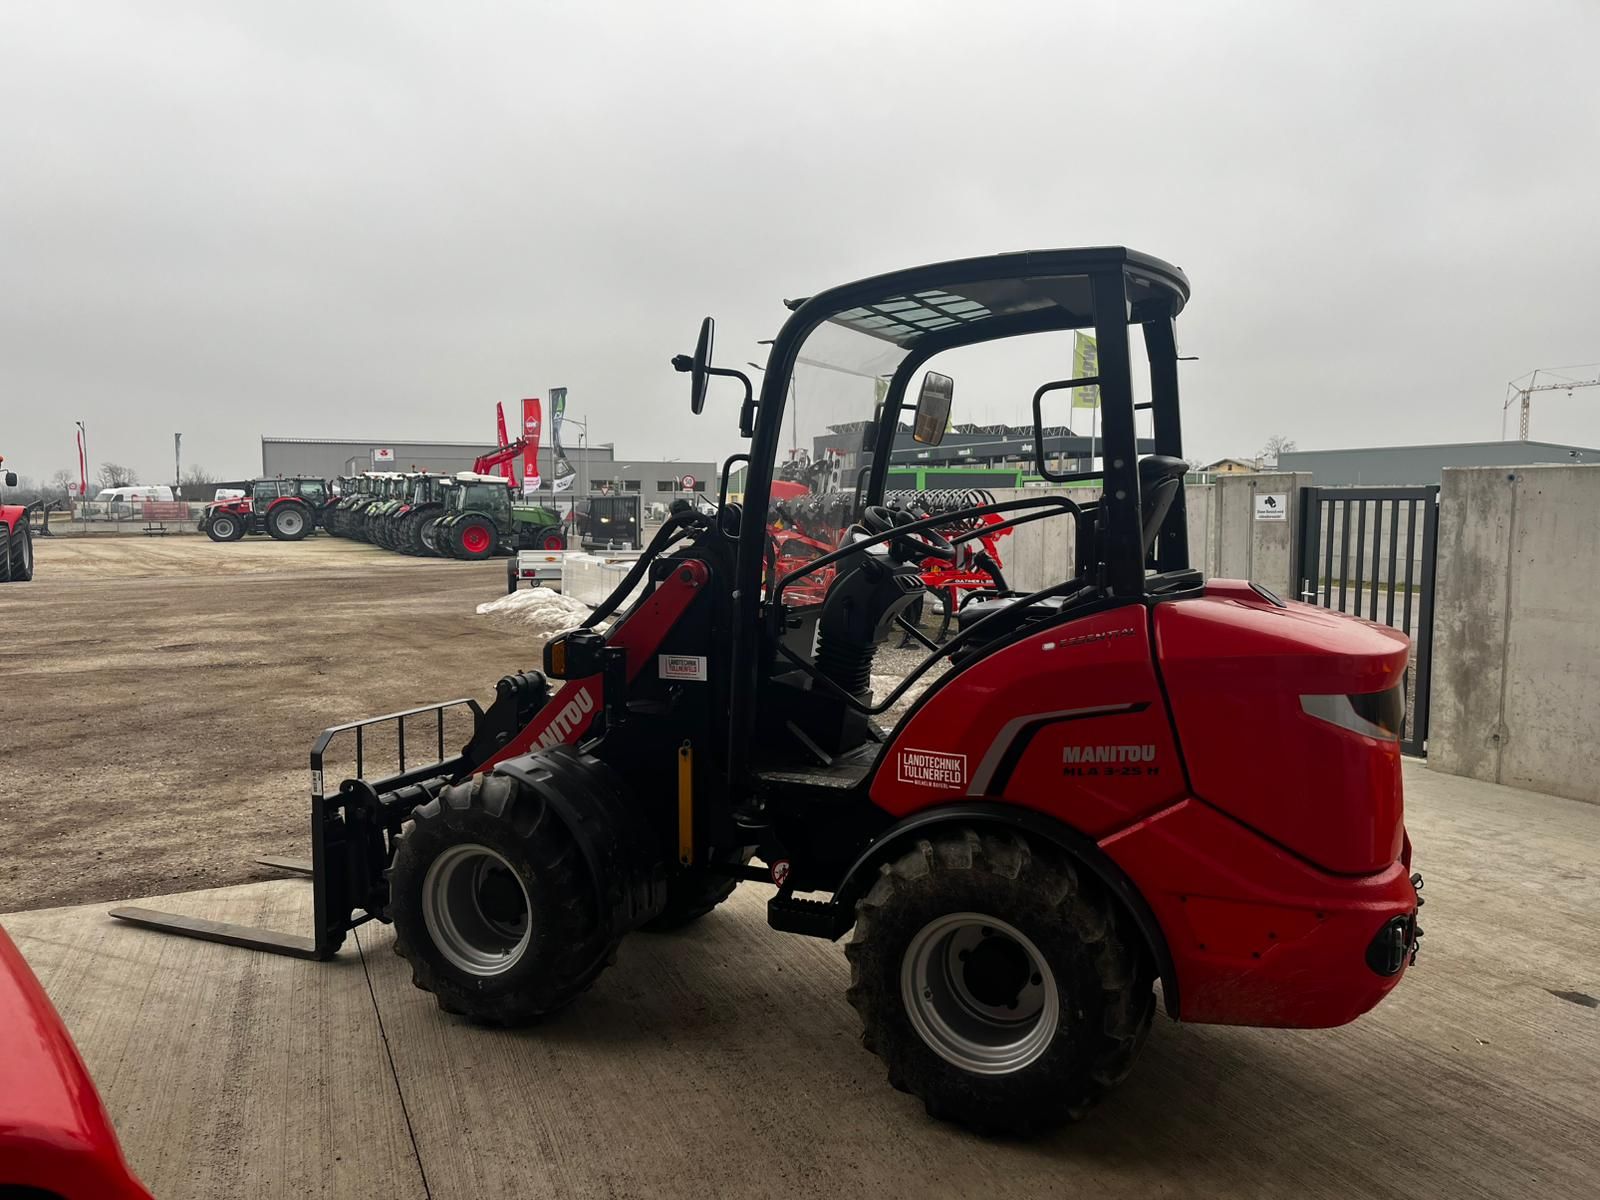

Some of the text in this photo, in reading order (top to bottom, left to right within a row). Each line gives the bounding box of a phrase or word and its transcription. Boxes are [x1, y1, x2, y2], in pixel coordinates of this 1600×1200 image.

[903, 753, 961, 771] LANDTECHNIK
[1062, 744, 1156, 763] MANITOU
[903, 765, 961, 783] TULLNERFELD
[1063, 767, 1099, 776] MLA
[1146, 767, 1160, 775] H
